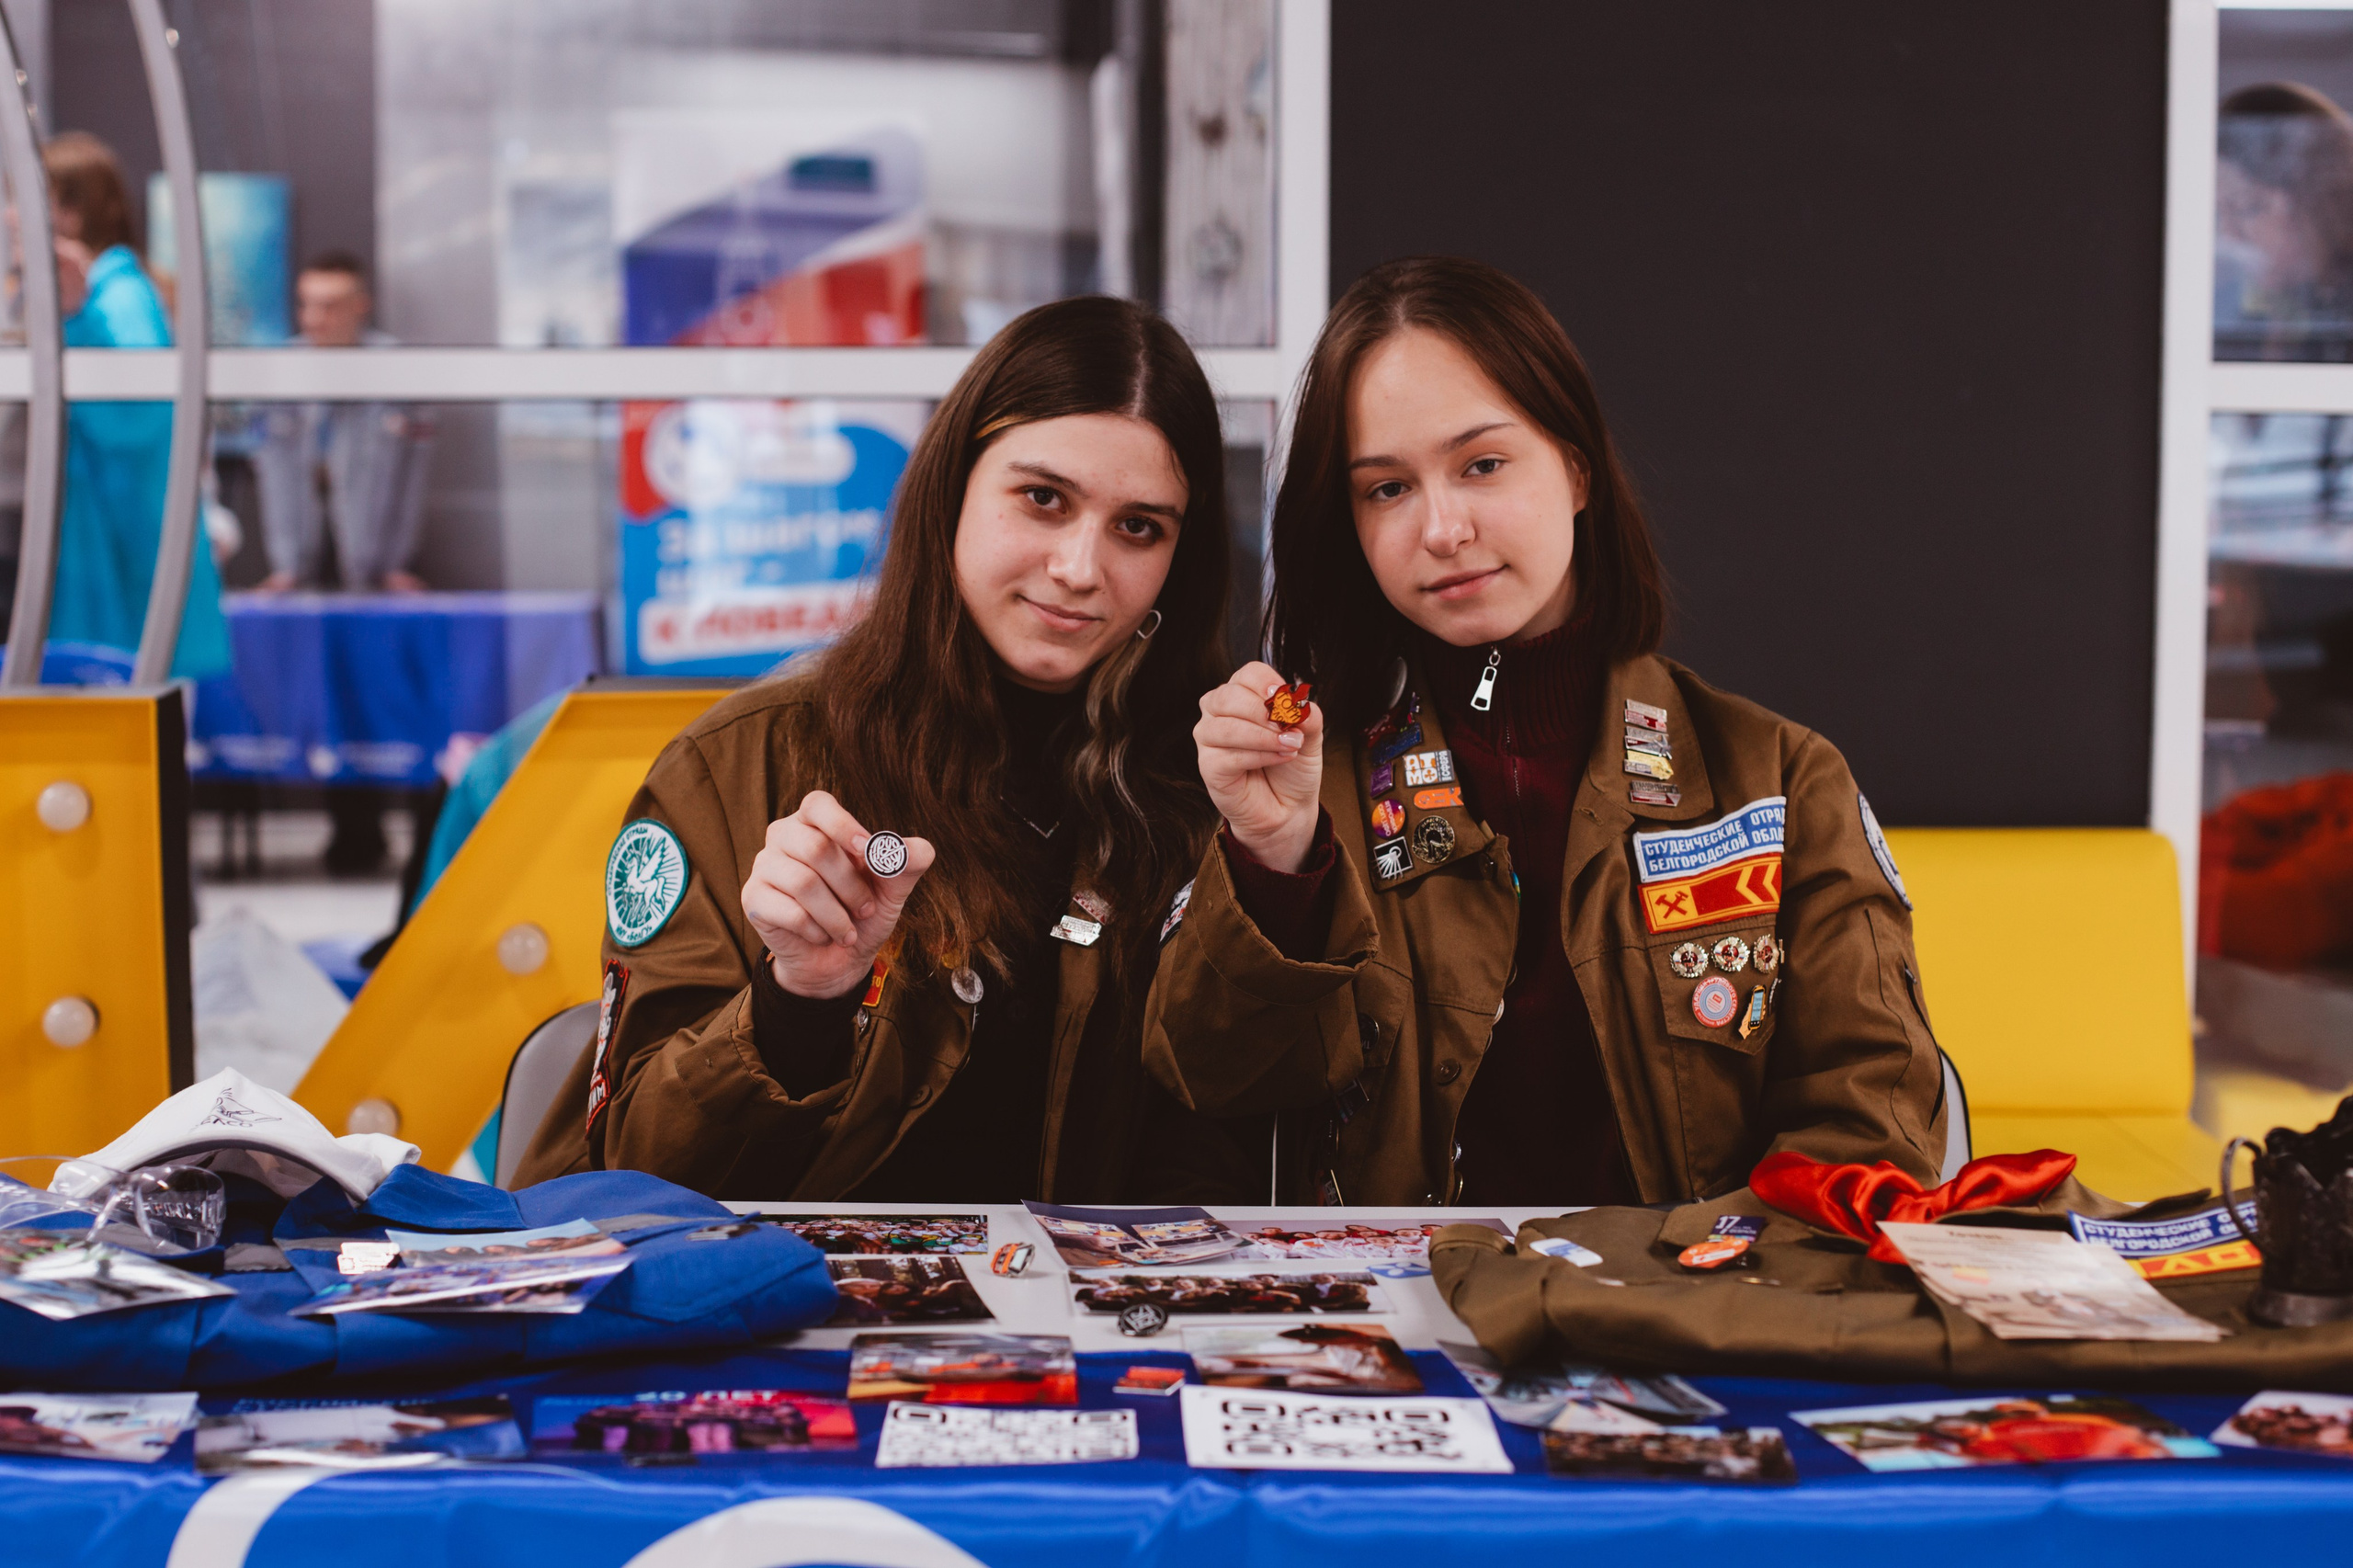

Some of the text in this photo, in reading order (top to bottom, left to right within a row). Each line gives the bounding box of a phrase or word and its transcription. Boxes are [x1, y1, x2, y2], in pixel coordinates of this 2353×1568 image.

[1644, 820, 1743, 856] СТУДЕНЧЕСКИЕ
[1648, 833, 1749, 872] БЕЛГОРОДСКОЙ
[1715, 1215, 1742, 1235] 17
